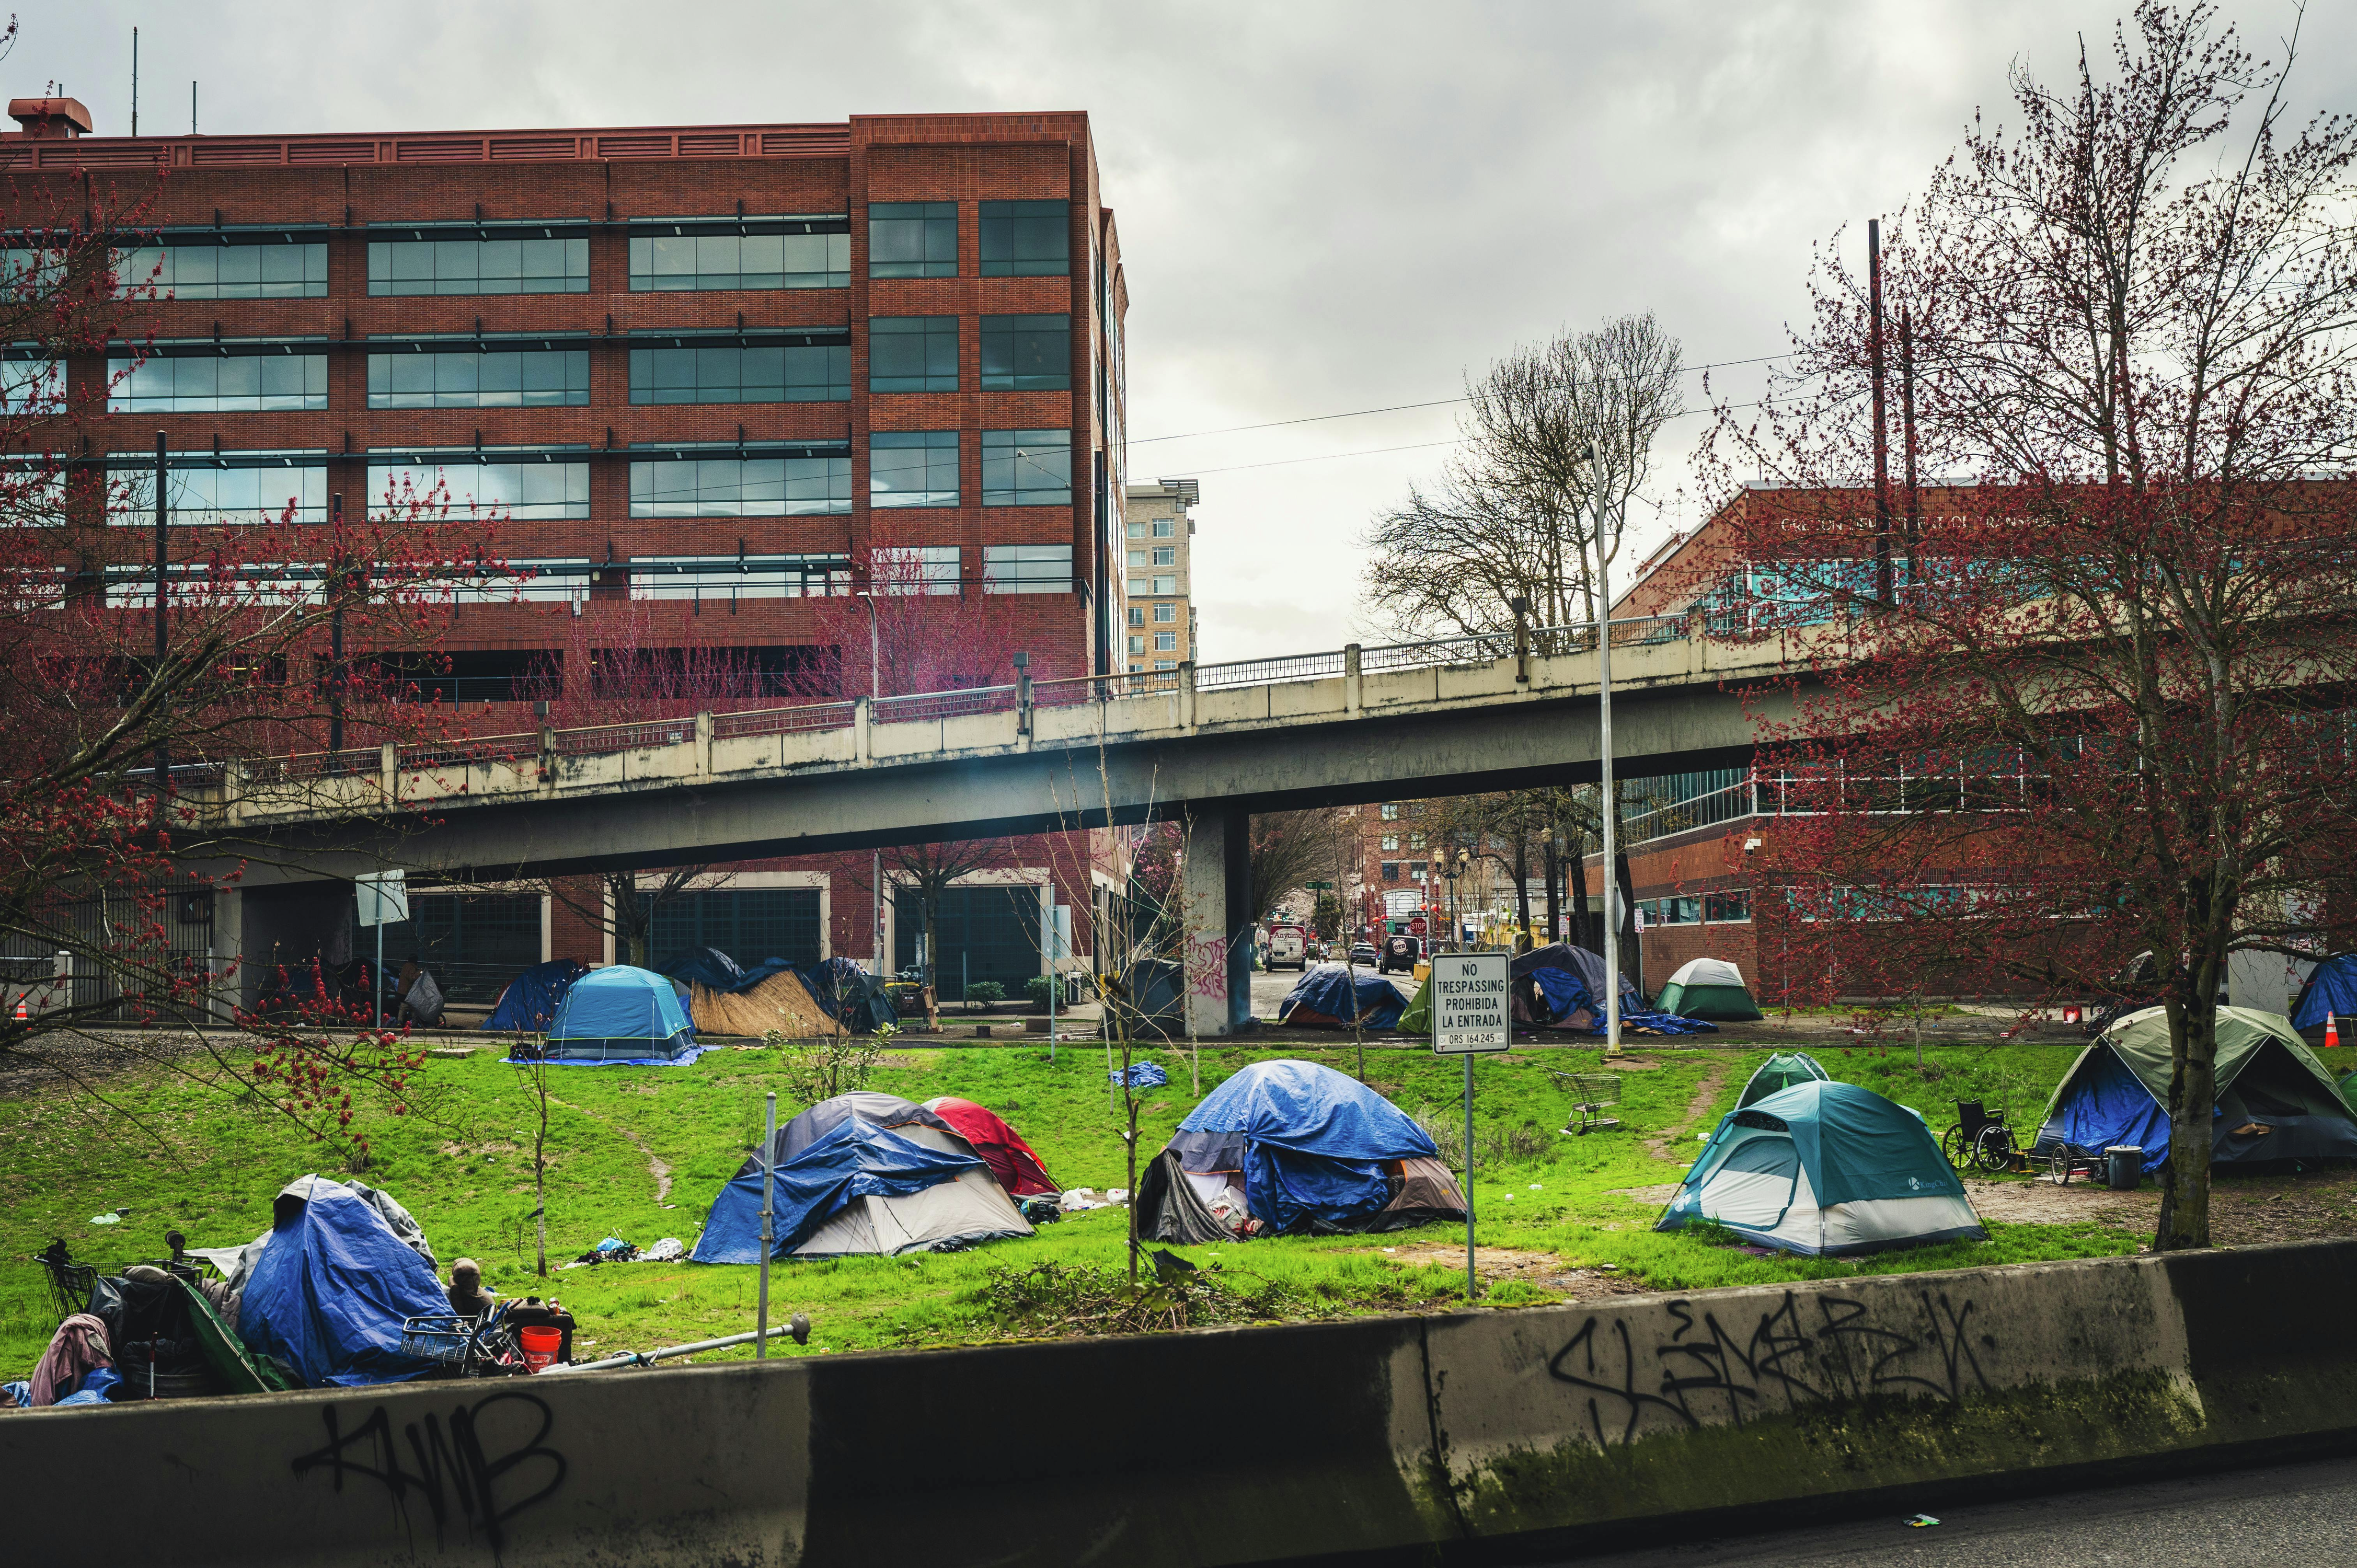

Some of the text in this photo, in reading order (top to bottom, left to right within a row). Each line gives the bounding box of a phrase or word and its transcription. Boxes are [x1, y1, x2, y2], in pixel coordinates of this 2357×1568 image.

[1781, 518, 1842, 532] OREON
[1462, 963, 1477, 976] NO
[1438, 979, 1504, 994] TRESPASSING
[1446, 997, 1498, 1011] PROHIBIDA
[1443, 1014, 1502, 1028] LA ENTRADA
[1449, 1034, 1463, 1044] ORS
[1467, 1033, 1494, 1043] 164.245
